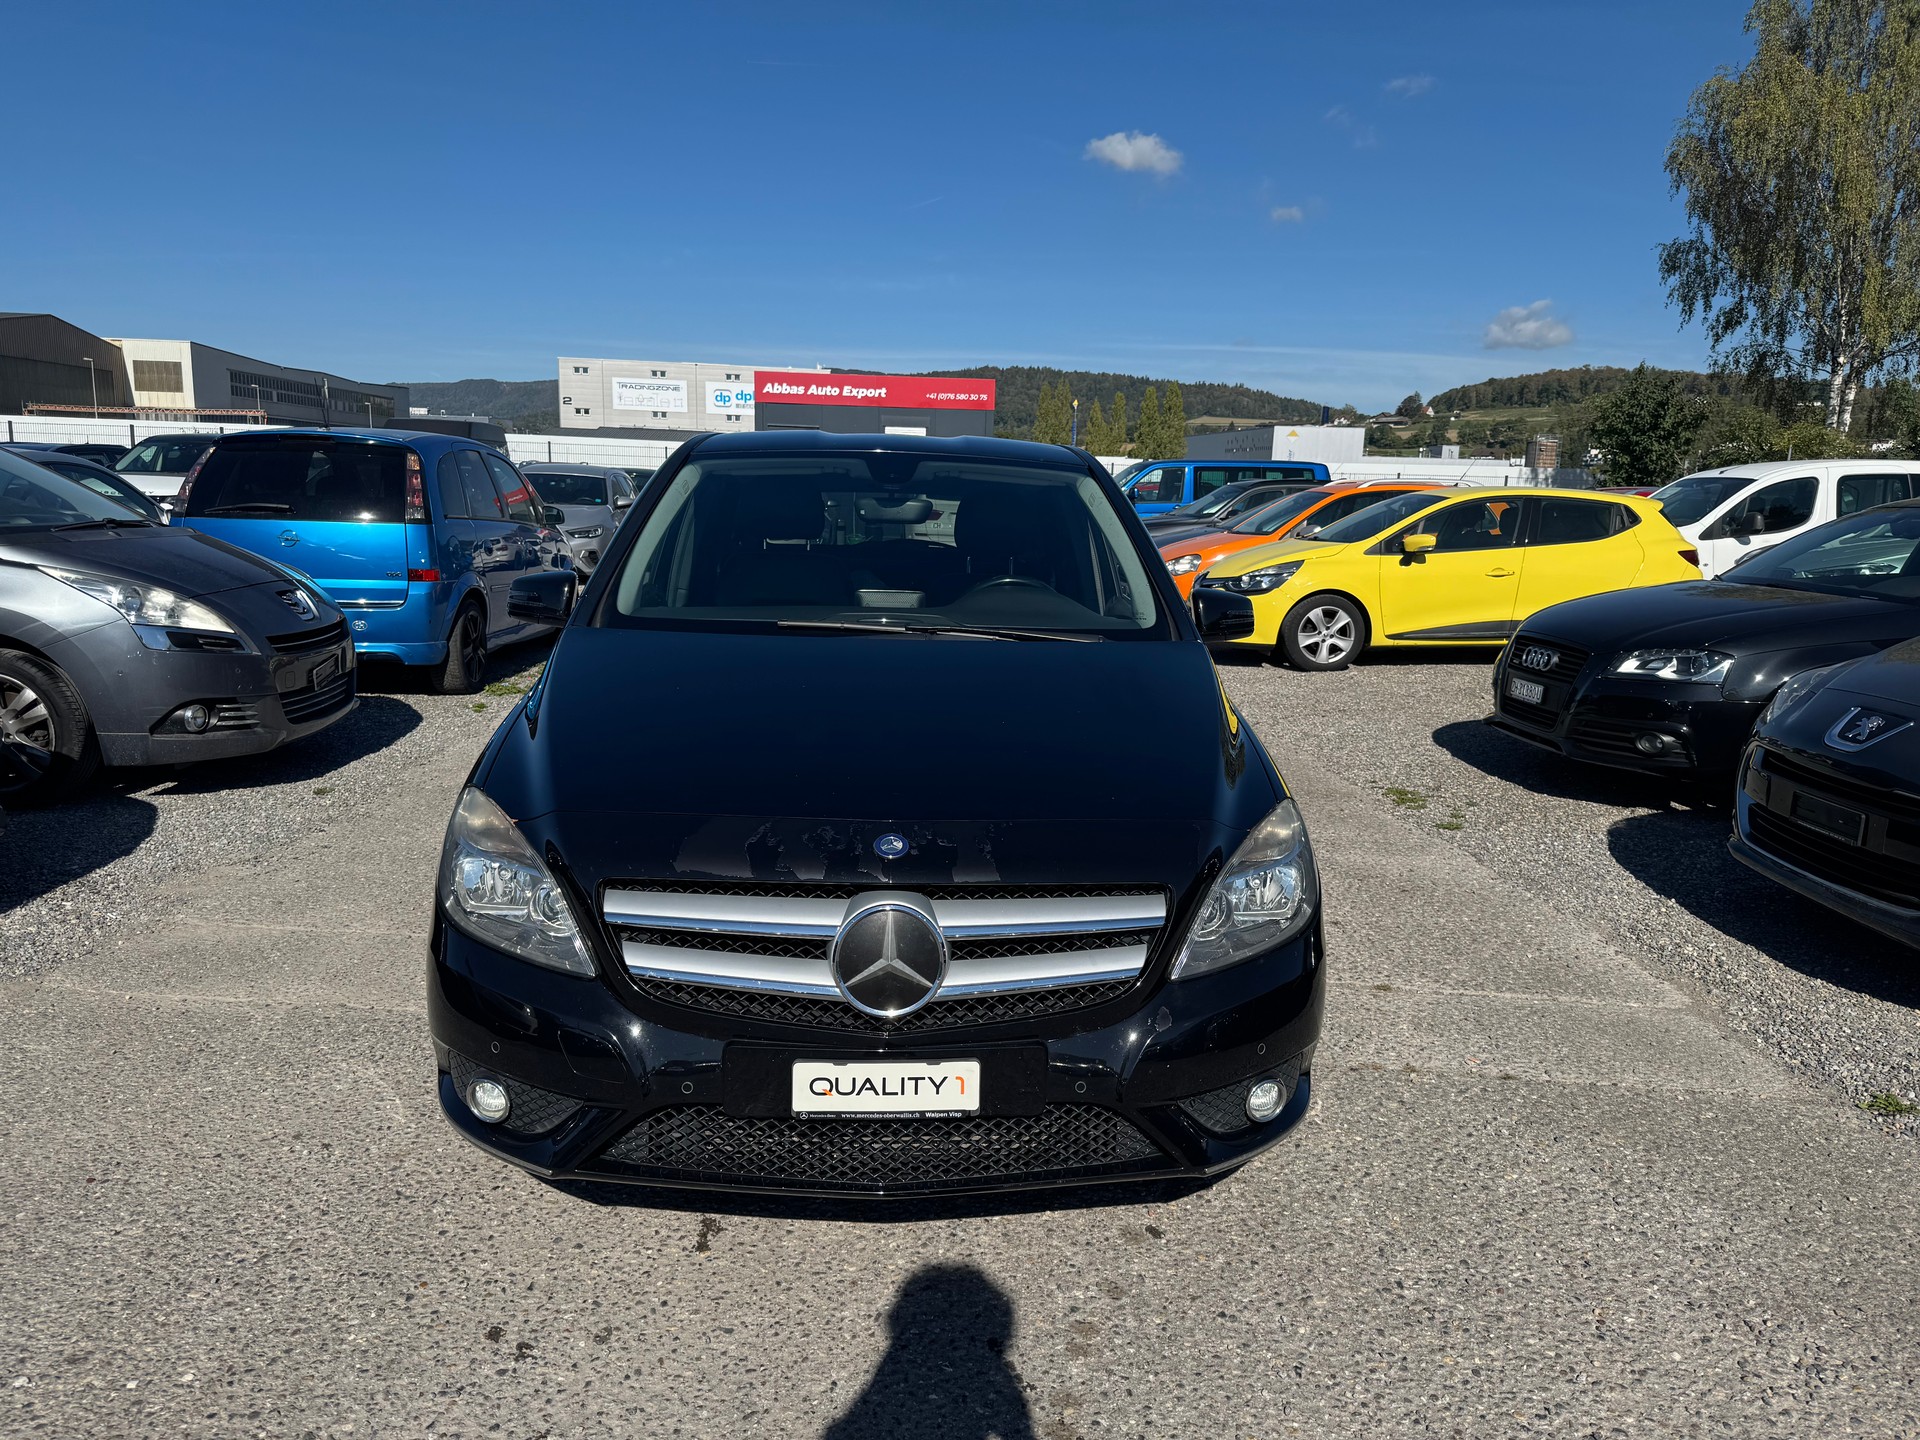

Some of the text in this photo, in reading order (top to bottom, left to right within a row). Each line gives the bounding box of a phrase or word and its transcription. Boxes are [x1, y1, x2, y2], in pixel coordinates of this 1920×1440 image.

[616, 381, 681, 392] TRADINGZONE
[762, 382, 887, 399] Abbas Auto Export
[562, 396, 573, 406] 2
[714, 391, 731, 405] dp
[937, 392, 955, 401] (0)76
[969, 393, 979, 401] 30
[809, 1076, 966, 1097] QUALITY 1
[925, 1111, 948, 1119] Walpen
